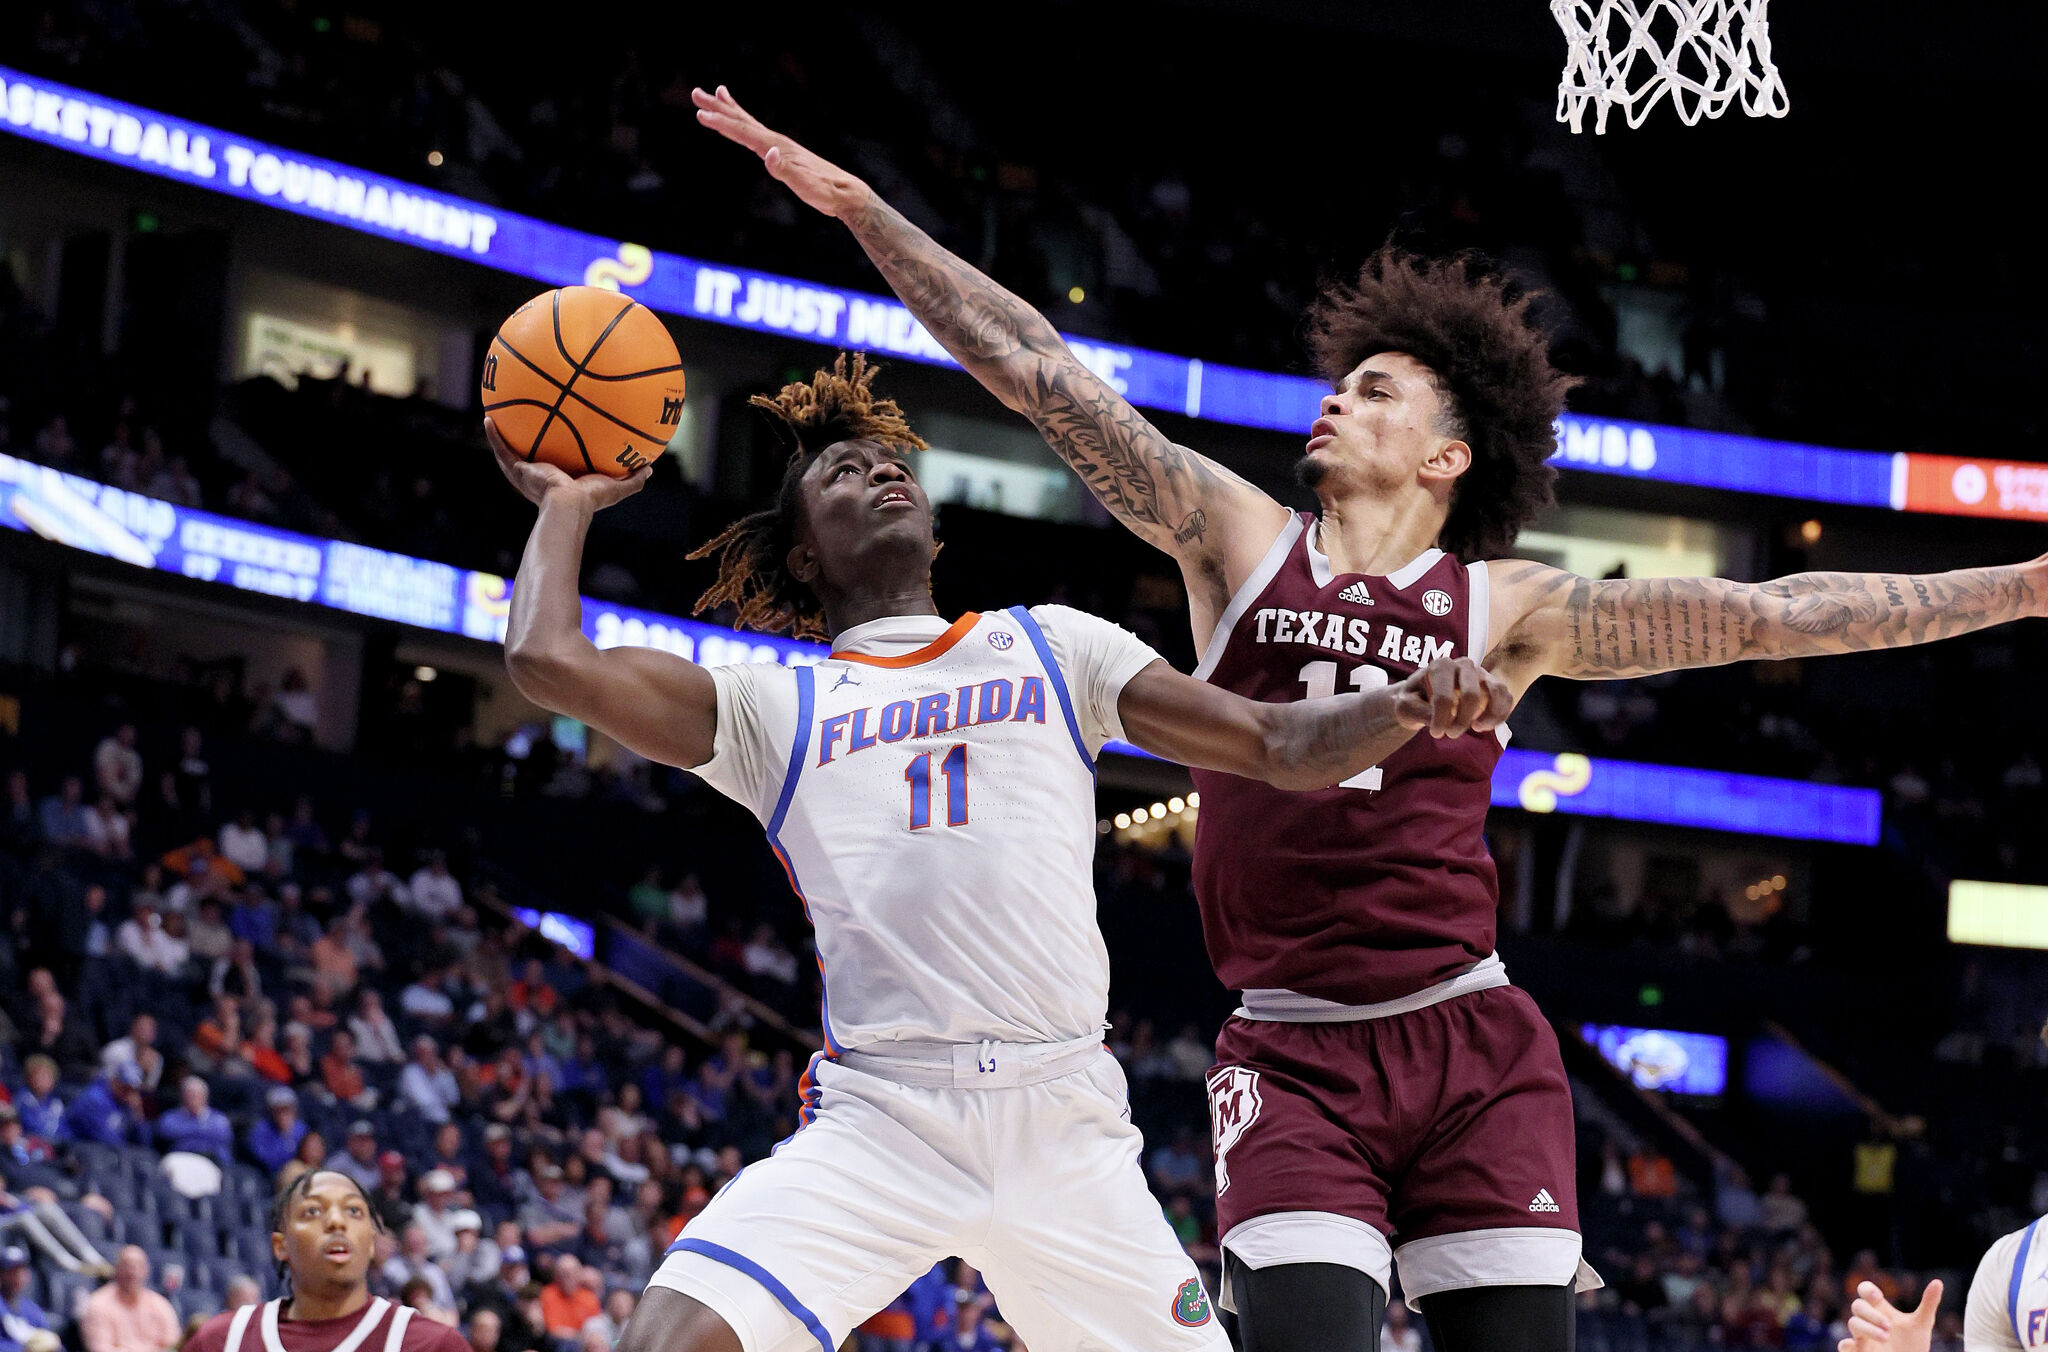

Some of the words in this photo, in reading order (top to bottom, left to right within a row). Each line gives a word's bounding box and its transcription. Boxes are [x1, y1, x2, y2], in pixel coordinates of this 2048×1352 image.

[0, 78, 215, 178] SKETBALL
[224, 145, 497, 254] TOURNAMENT
[694, 268, 742, 317] IT
[736, 278, 846, 338] JUST
[847, 298, 958, 362] MEA
[1253, 608, 1370, 656] TEXAS
[1377, 625, 1455, 669] A&M
[1338, 592, 1375, 606] adidas
[816, 676, 1046, 768] FLORIDA
[904, 743, 969, 830] 11
[1528, 1203, 1560, 1212] adidas
